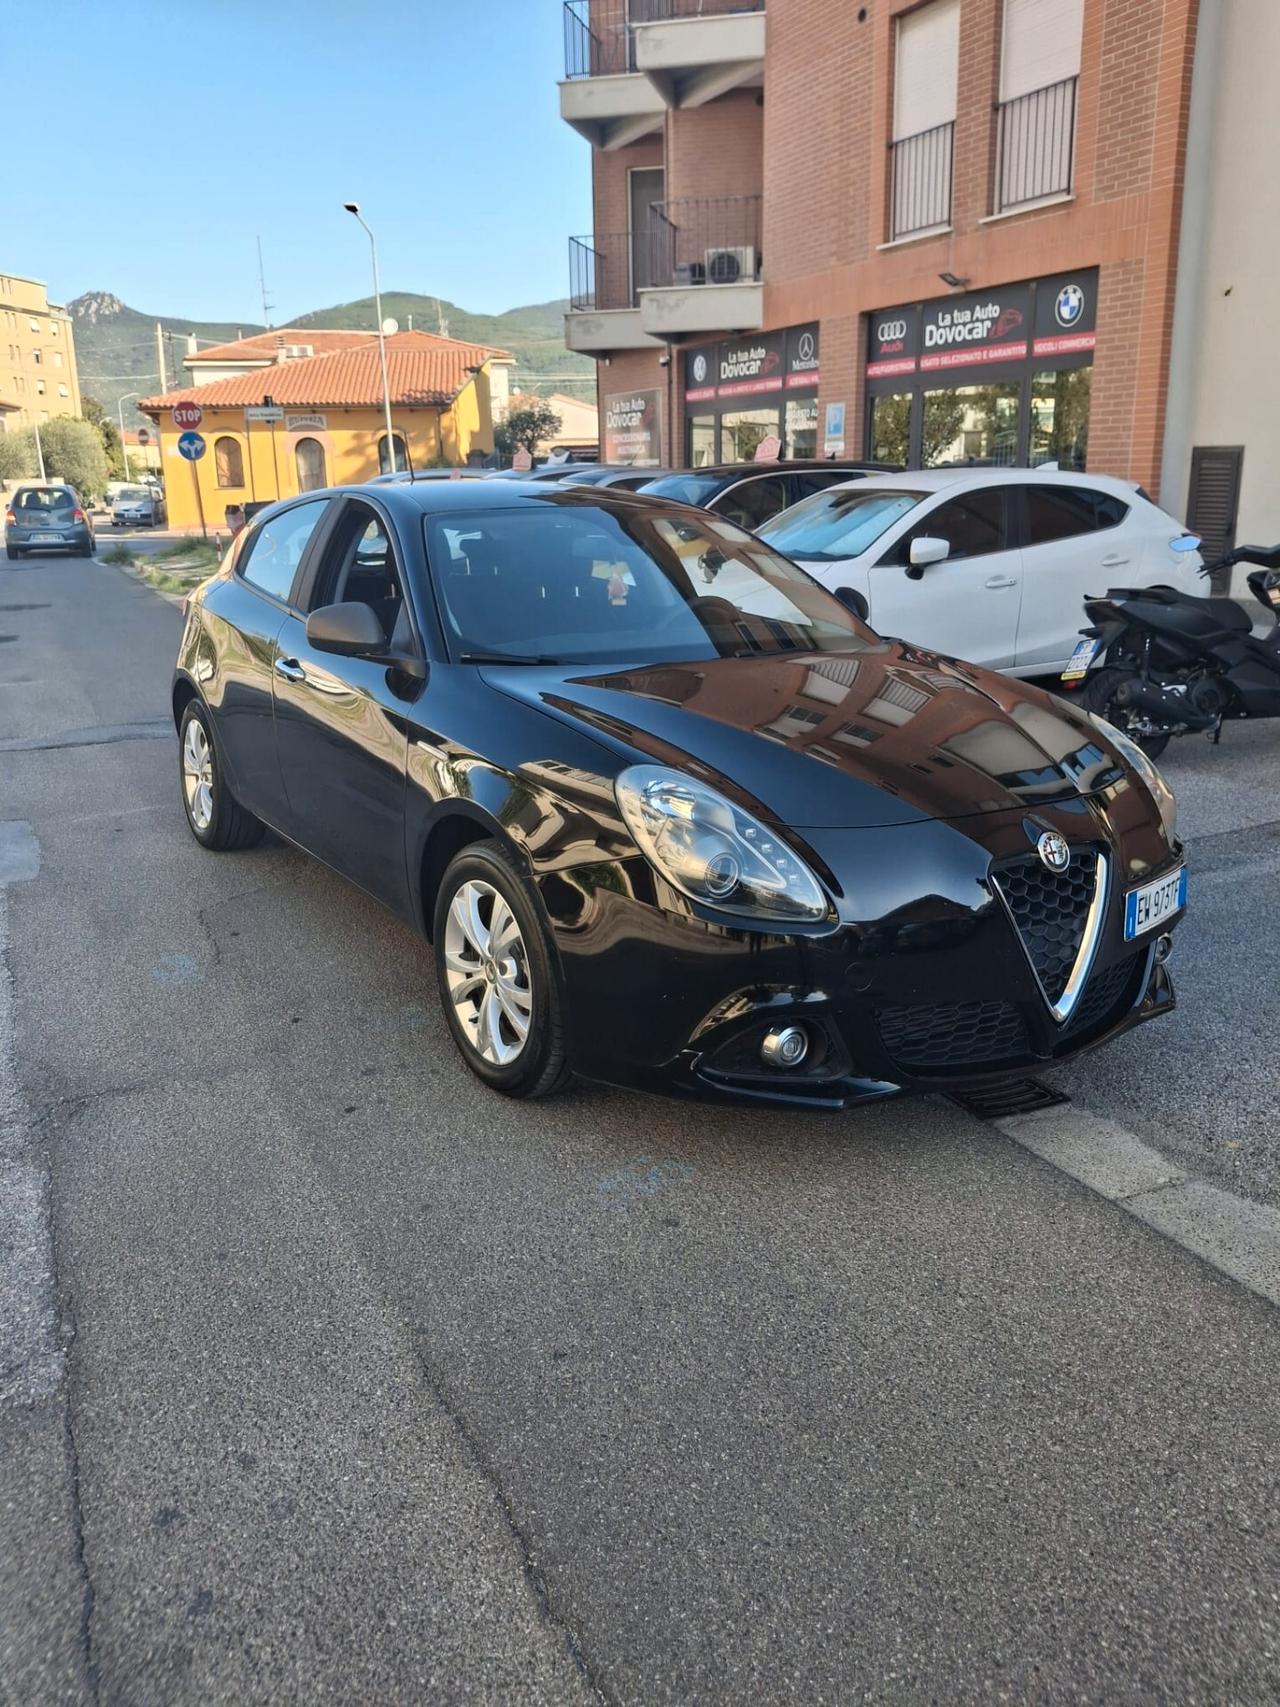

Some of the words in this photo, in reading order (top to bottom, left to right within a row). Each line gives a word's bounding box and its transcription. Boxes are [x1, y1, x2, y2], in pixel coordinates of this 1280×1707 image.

[938, 311, 951, 328] La
[953, 307, 971, 324] tua
[973, 302, 1000, 322] Auto
[925, 320, 992, 347] Dovocar
[728, 352, 737, 364] La
[738, 350, 749, 362] tua
[750, 346, 766, 360] Auto
[720, 360, 761, 379] Dovocar
[612, 401, 620, 413] La
[631, 398, 646, 411] Auto
[174, 409, 201, 423] STOP
[606, 411, 642, 428] Dovocar
